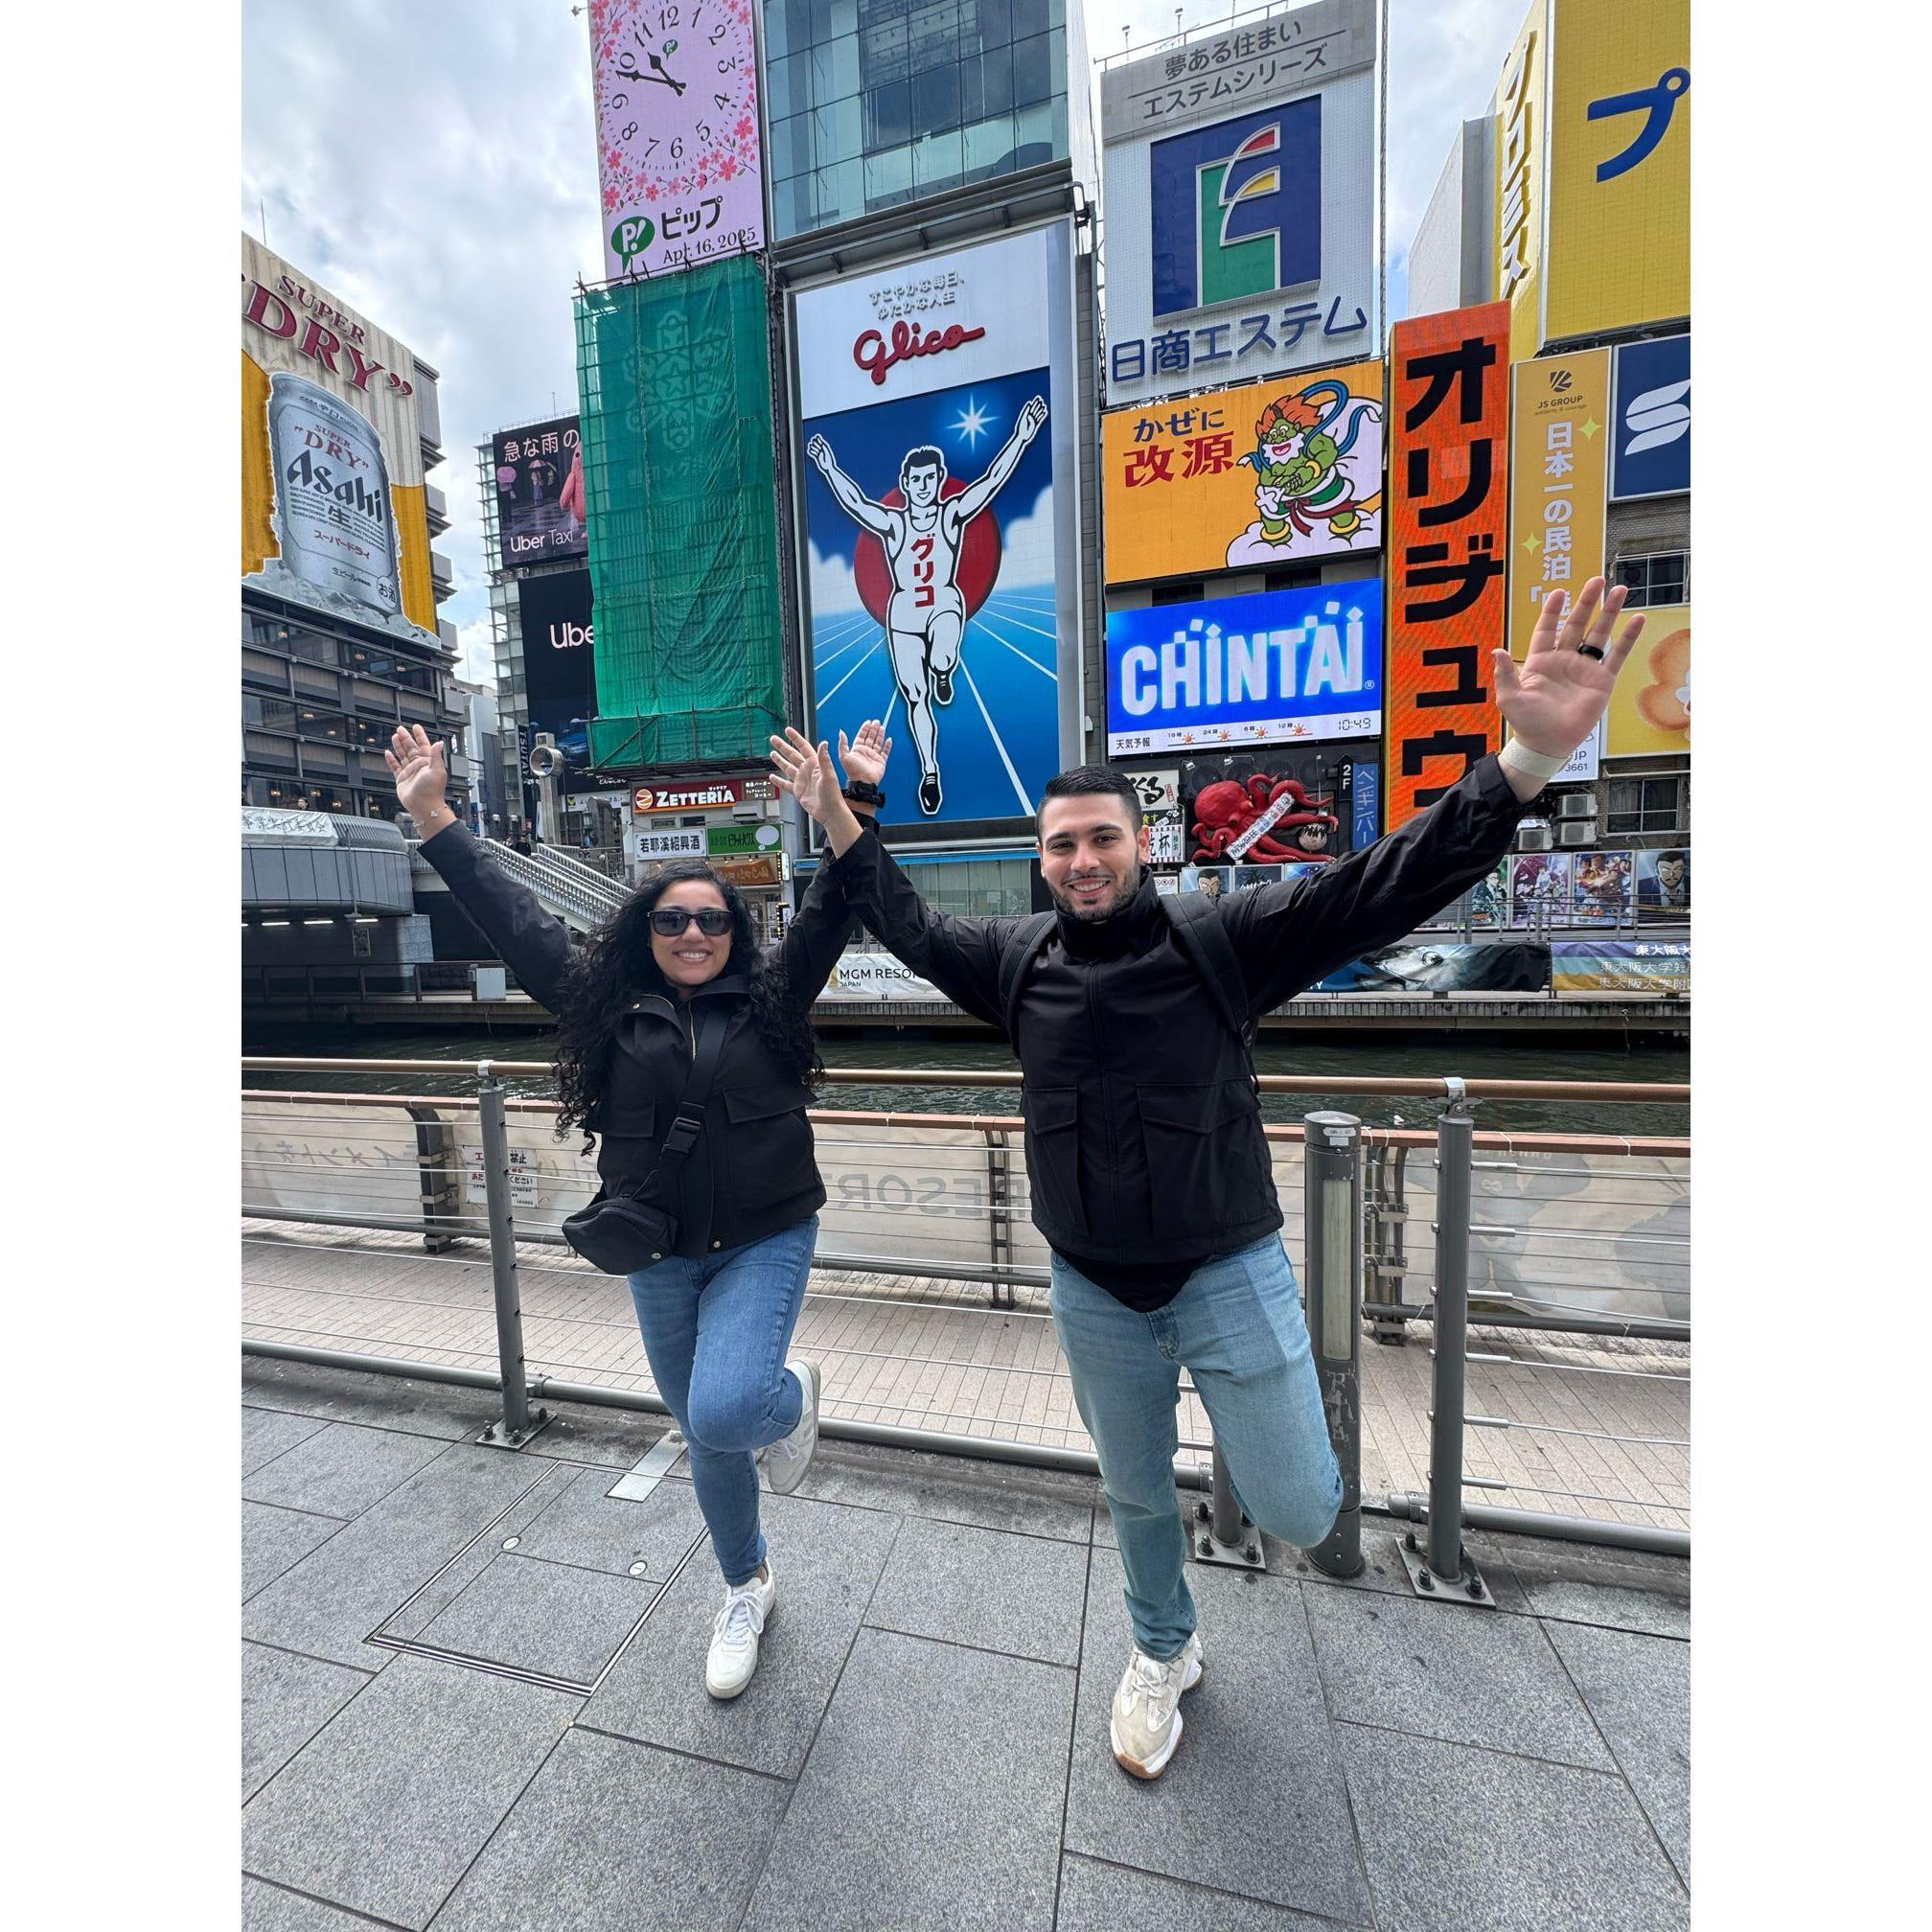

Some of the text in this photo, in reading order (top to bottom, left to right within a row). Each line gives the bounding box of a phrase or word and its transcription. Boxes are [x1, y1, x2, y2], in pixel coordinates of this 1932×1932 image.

[658, 6, 680, 31] 12
[691, 7, 702, 29] 1
[633, 22, 654, 48] 11
[707, 24, 726, 46] 2
[1164, 20, 1301, 80] 夢ある住まい
[717, 58, 737, 75] 3
[1143, 42, 1328, 120] エステムシリーズ
[611, 93, 630, 110] 9
[714, 92, 731, 111] 4
[621, 121, 638, 141] 8
[695, 119, 712, 143] 5
[1587, 67, 1690, 183] プ
[644, 137, 661, 158] 7
[670, 137, 684, 159] 6
[661, 195, 724, 241] ピップ
[696, 238, 716, 255] 16,
[718, 226, 756, 248] 2025
[279, 274, 366, 345] SUPER
[877, 291, 956, 321] ゆたかな人生
[1112, 295, 1368, 383] 日商エステム
[1537, 395, 1583, 409] JS GROUP
[314, 424, 352, 448] SUPER
[1134, 407, 1225, 443] かぜに
[503, 428, 580, 464] 急な雨の
[1123, 430, 1234, 488] 改源
[287, 449, 382, 523] Asahi
[1542, 421, 1575, 582] 日本一の民泊
[328, 505, 353, 530] 生
[510, 528, 575, 554] Uber Taxi
[910, 532, 936, 609] グリコ
[1121, 601, 1365, 716] CHINTAI
[1338, 717, 1371, 731] 10:49
[1116, 737, 1151, 750] 天気予報
[1343, 764, 1351, 791] 2F
[656, 790, 736, 808] ZETTERIA
[840, 968, 871, 979] MGM
[1599, 960, 1690, 974] 東大阪大学短
[1598, 978, 1690, 991] 東大阪大学附
